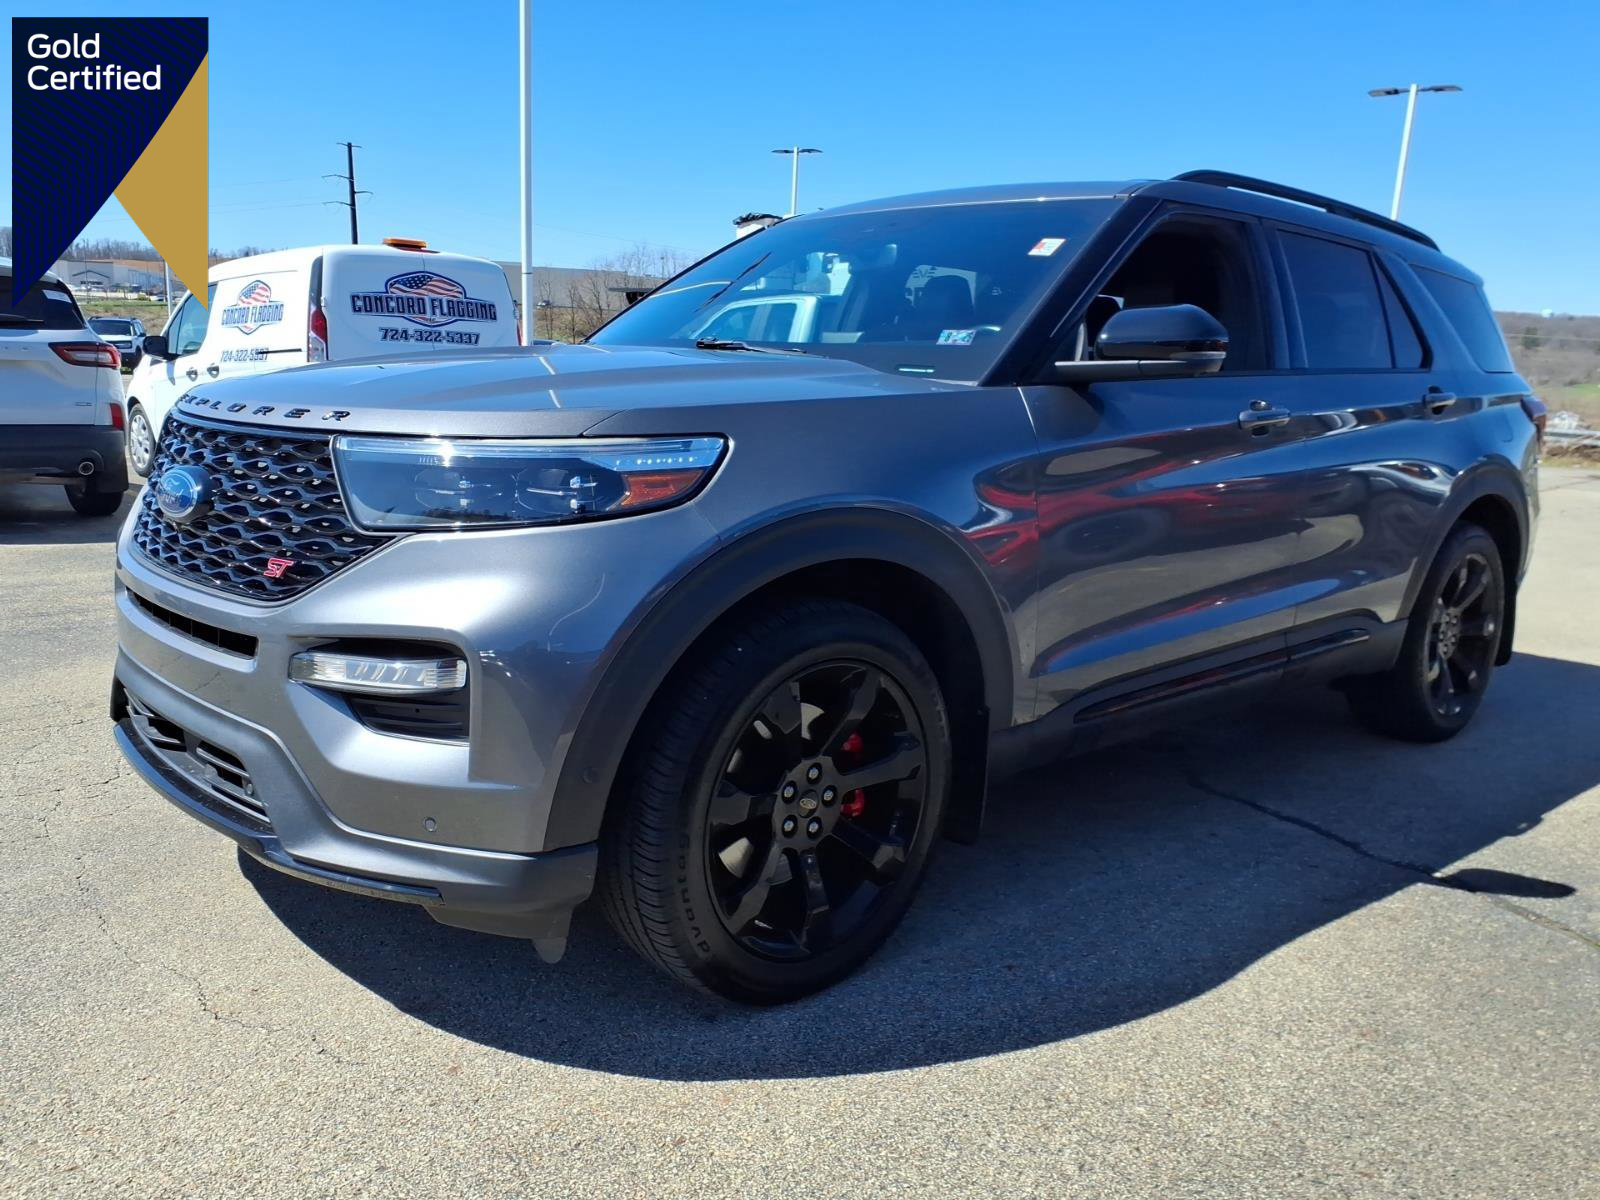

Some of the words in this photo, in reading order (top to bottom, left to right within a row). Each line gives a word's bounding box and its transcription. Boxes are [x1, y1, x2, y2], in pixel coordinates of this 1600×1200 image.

[222, 306, 250, 325] CONCORD
[351, 294, 427, 315] CONCORD
[430, 297, 497, 321] FLAGGING
[379, 327, 480, 346] 724-322-5337
[263, 557, 294, 578] ST
